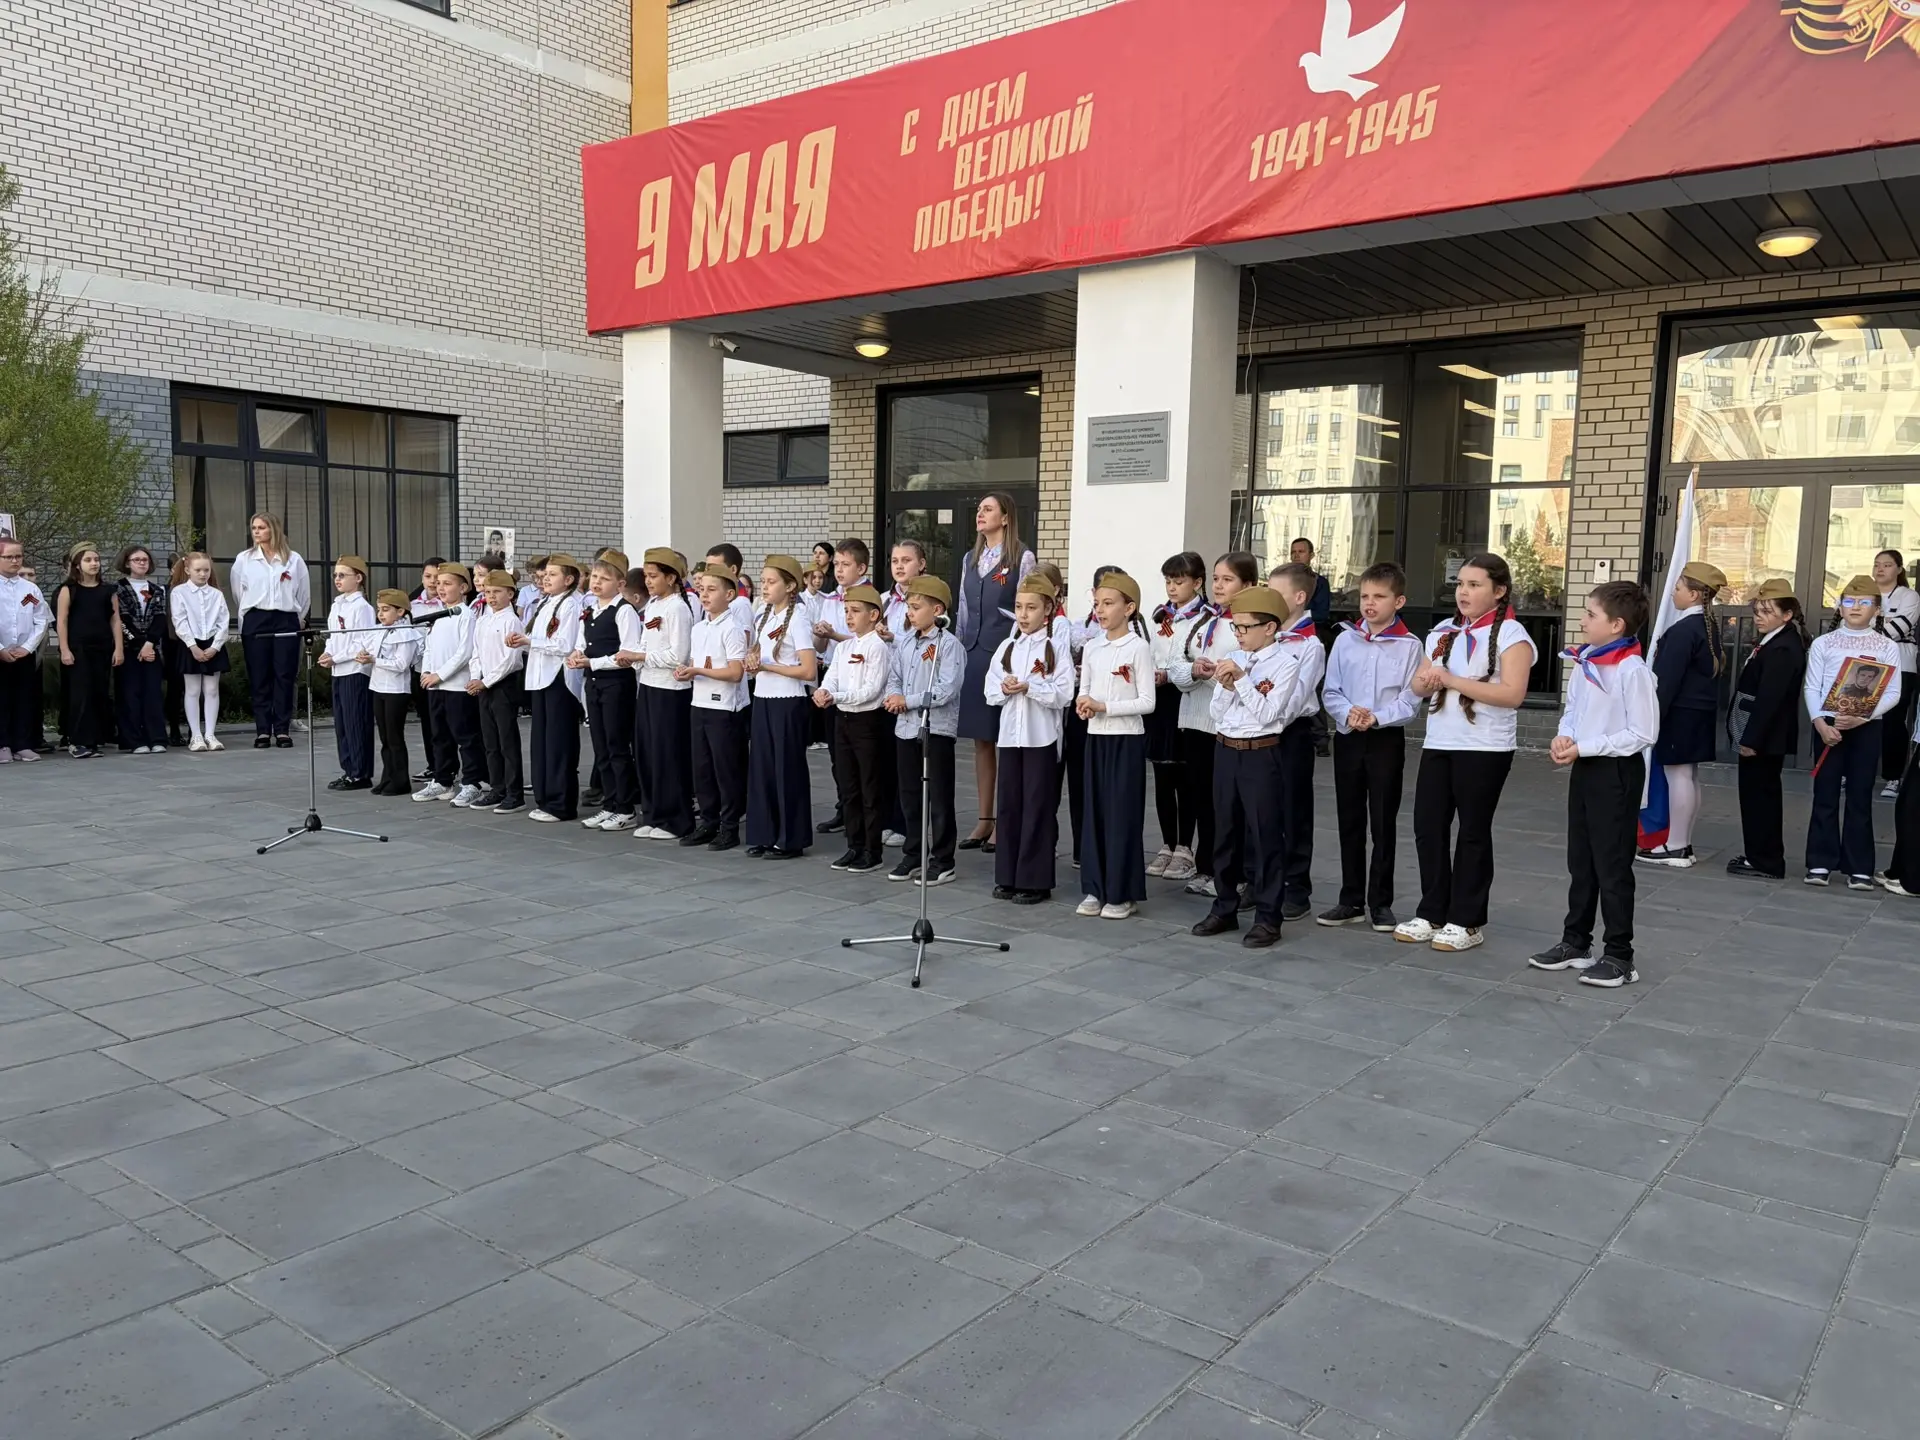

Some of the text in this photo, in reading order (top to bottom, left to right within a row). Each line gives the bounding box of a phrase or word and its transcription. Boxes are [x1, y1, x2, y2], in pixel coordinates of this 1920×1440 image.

[900, 71, 1028, 157] С ДНЕМ
[953, 92, 1095, 191] ВЕЛИКОЙ
[1248, 84, 1441, 182] 1941-1945
[634, 125, 837, 290] 9 МАЯ
[913, 171, 1046, 253] ПОБЕДЫ!
